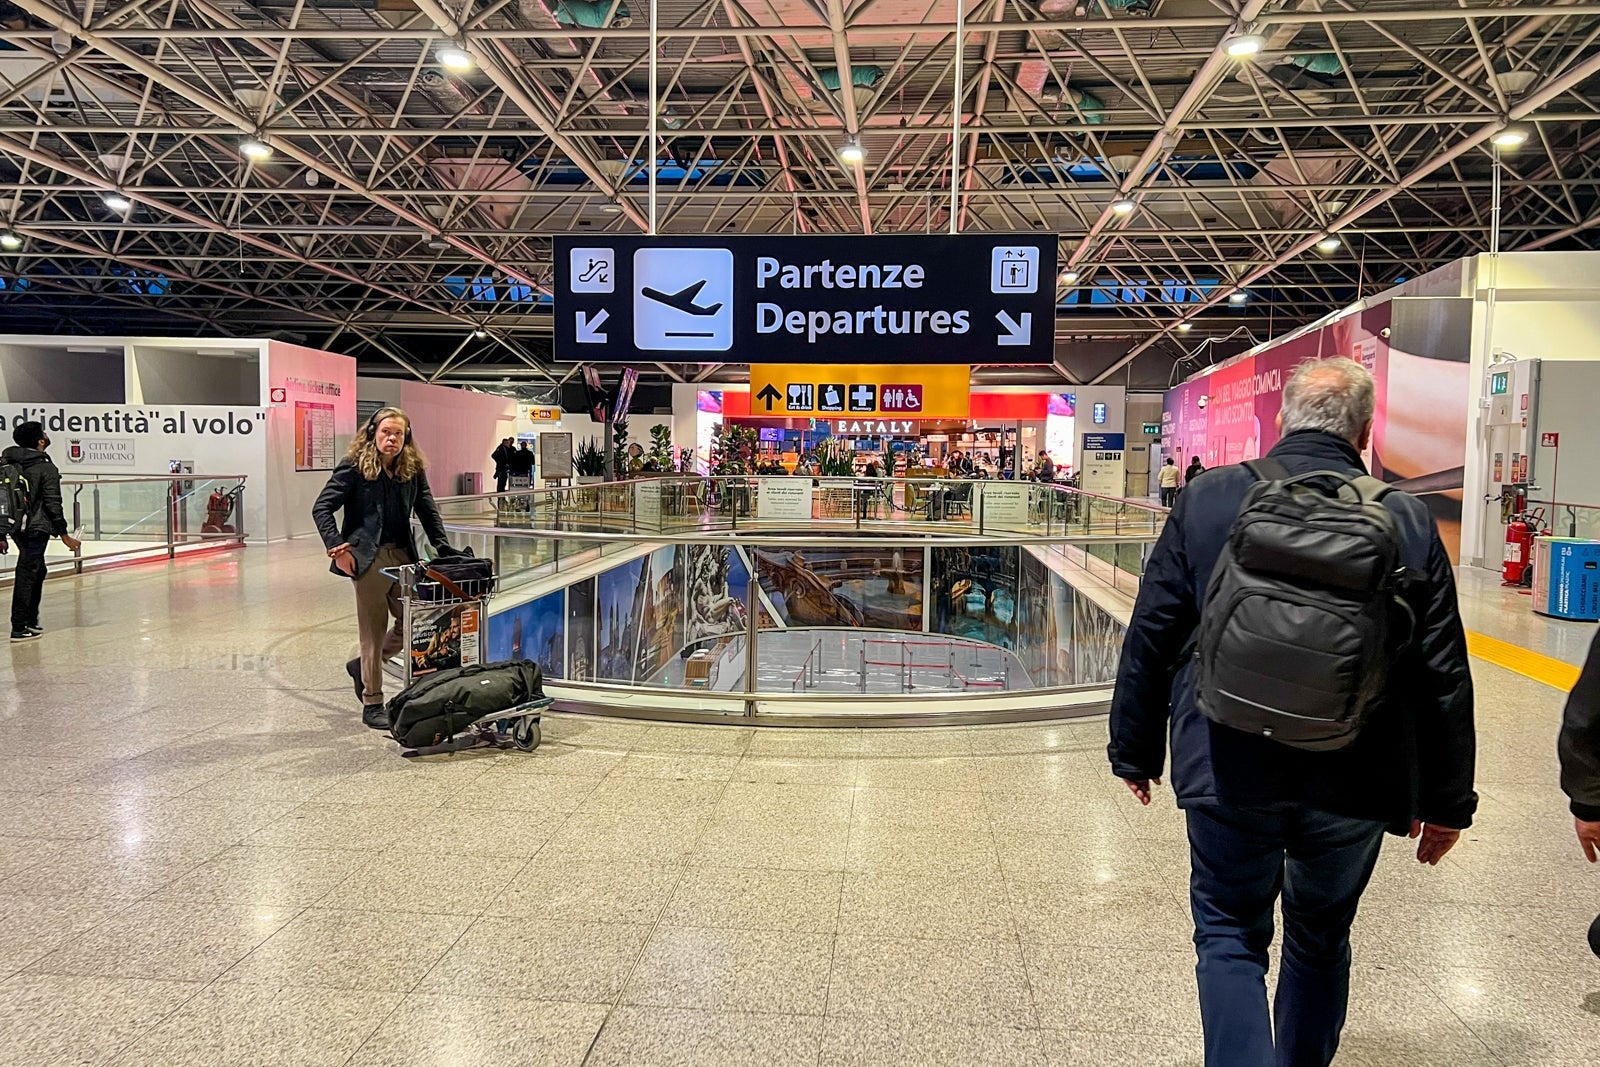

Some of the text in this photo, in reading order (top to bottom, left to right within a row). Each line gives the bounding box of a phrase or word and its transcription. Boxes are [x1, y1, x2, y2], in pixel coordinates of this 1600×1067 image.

[756, 256, 926, 289] Partenze
[756, 302, 971, 343] Departures
[324, 383, 341, 397] office
[1231, 377, 1252, 401] VIAGGIO
[1252, 368, 1282, 397] COMINCIA
[838, 420, 914, 433] EATALY
[117, 443, 126, 451] DI
[89, 453, 135, 461] FIUMICINO
